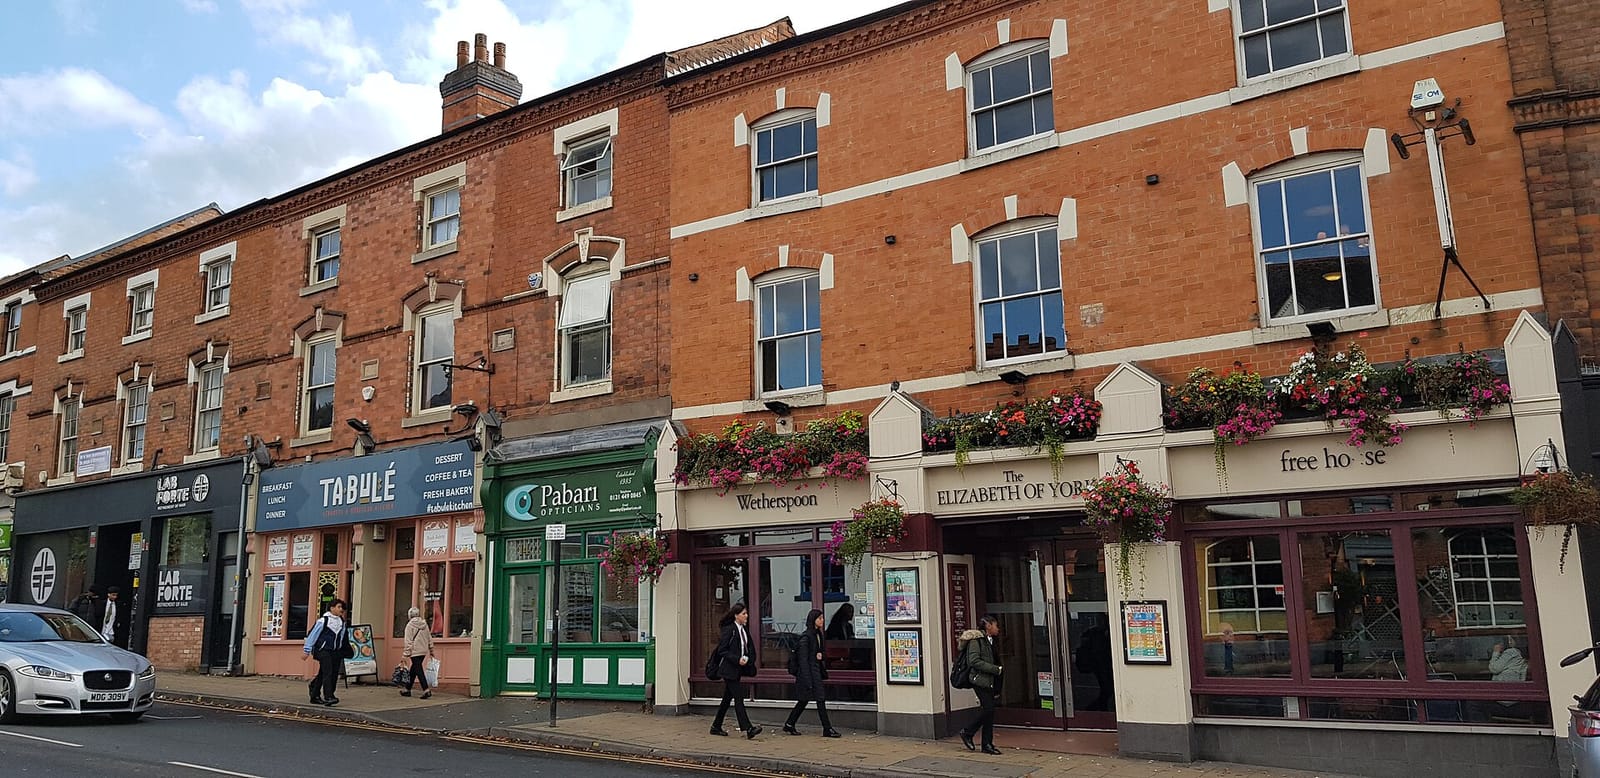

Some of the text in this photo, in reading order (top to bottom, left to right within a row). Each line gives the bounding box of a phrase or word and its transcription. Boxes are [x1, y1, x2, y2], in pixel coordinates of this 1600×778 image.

[435, 452, 463, 465] DESSERT
[1281, 447, 1386, 472] free hose
[425, 469, 472, 482] COFFEE & TEA
[1003, 470, 1024, 482] The
[157, 475, 178, 491] LAB
[262, 481, 293, 493] BREAKFAST
[155, 487, 190, 505] FORTE
[267, 495, 286, 505] LUNCH
[423, 486, 473, 500] FRESH BAKERY
[936, 484, 1021, 505] ELIZABETH
[1023, 483, 1045, 499] OF
[736, 492, 818, 513] Wetherspoon
[265, 510, 286, 519] DINNER
[540, 503, 601, 517] OPTICIANS
[158, 570, 180, 585] LAB
[157, 585, 193, 601] FORTE
